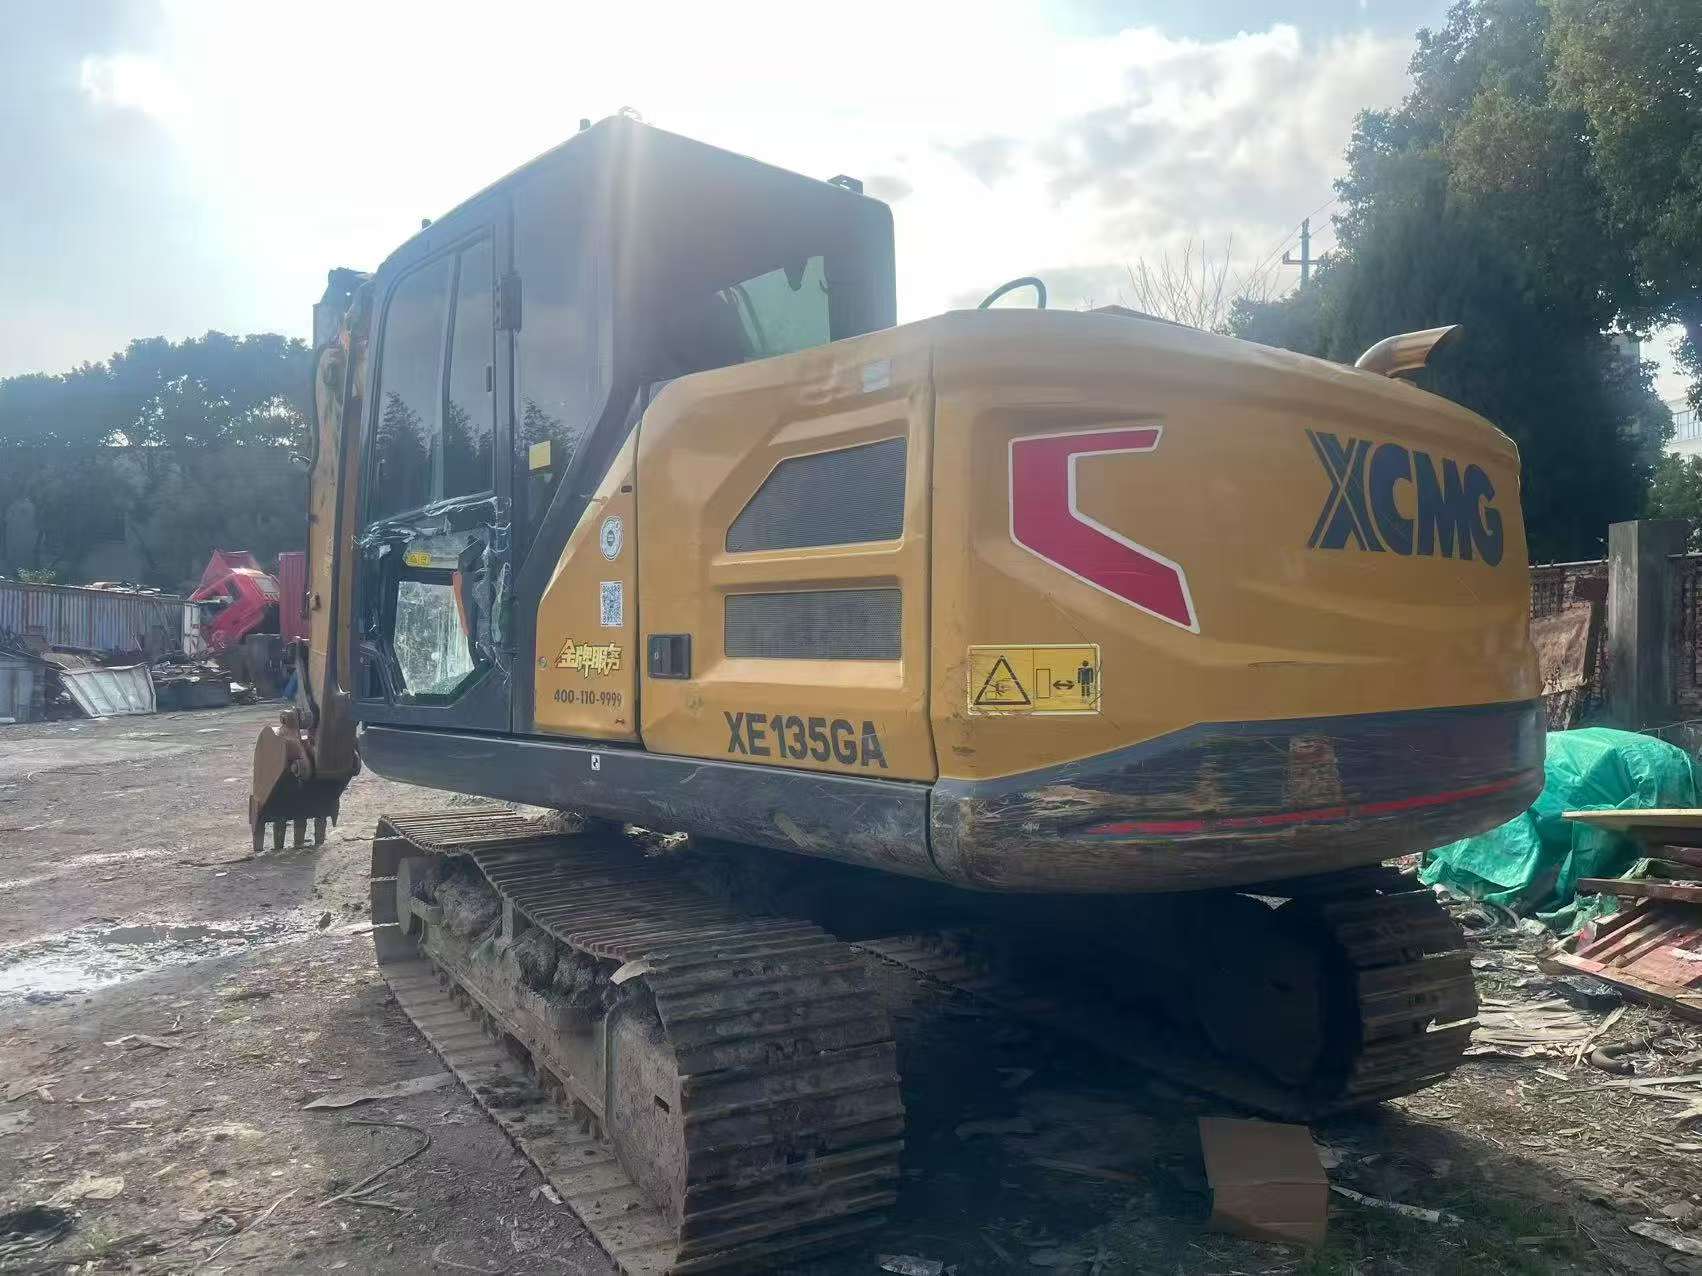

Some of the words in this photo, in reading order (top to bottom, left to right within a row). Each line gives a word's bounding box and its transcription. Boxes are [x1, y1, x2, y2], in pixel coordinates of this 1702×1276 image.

[1305, 429, 1503, 567] XCMG
[555, 638, 622, 679] 金牌服务
[554, 689, 622, 706] 400-110-9999
[723, 710, 889, 769] XE135GA
